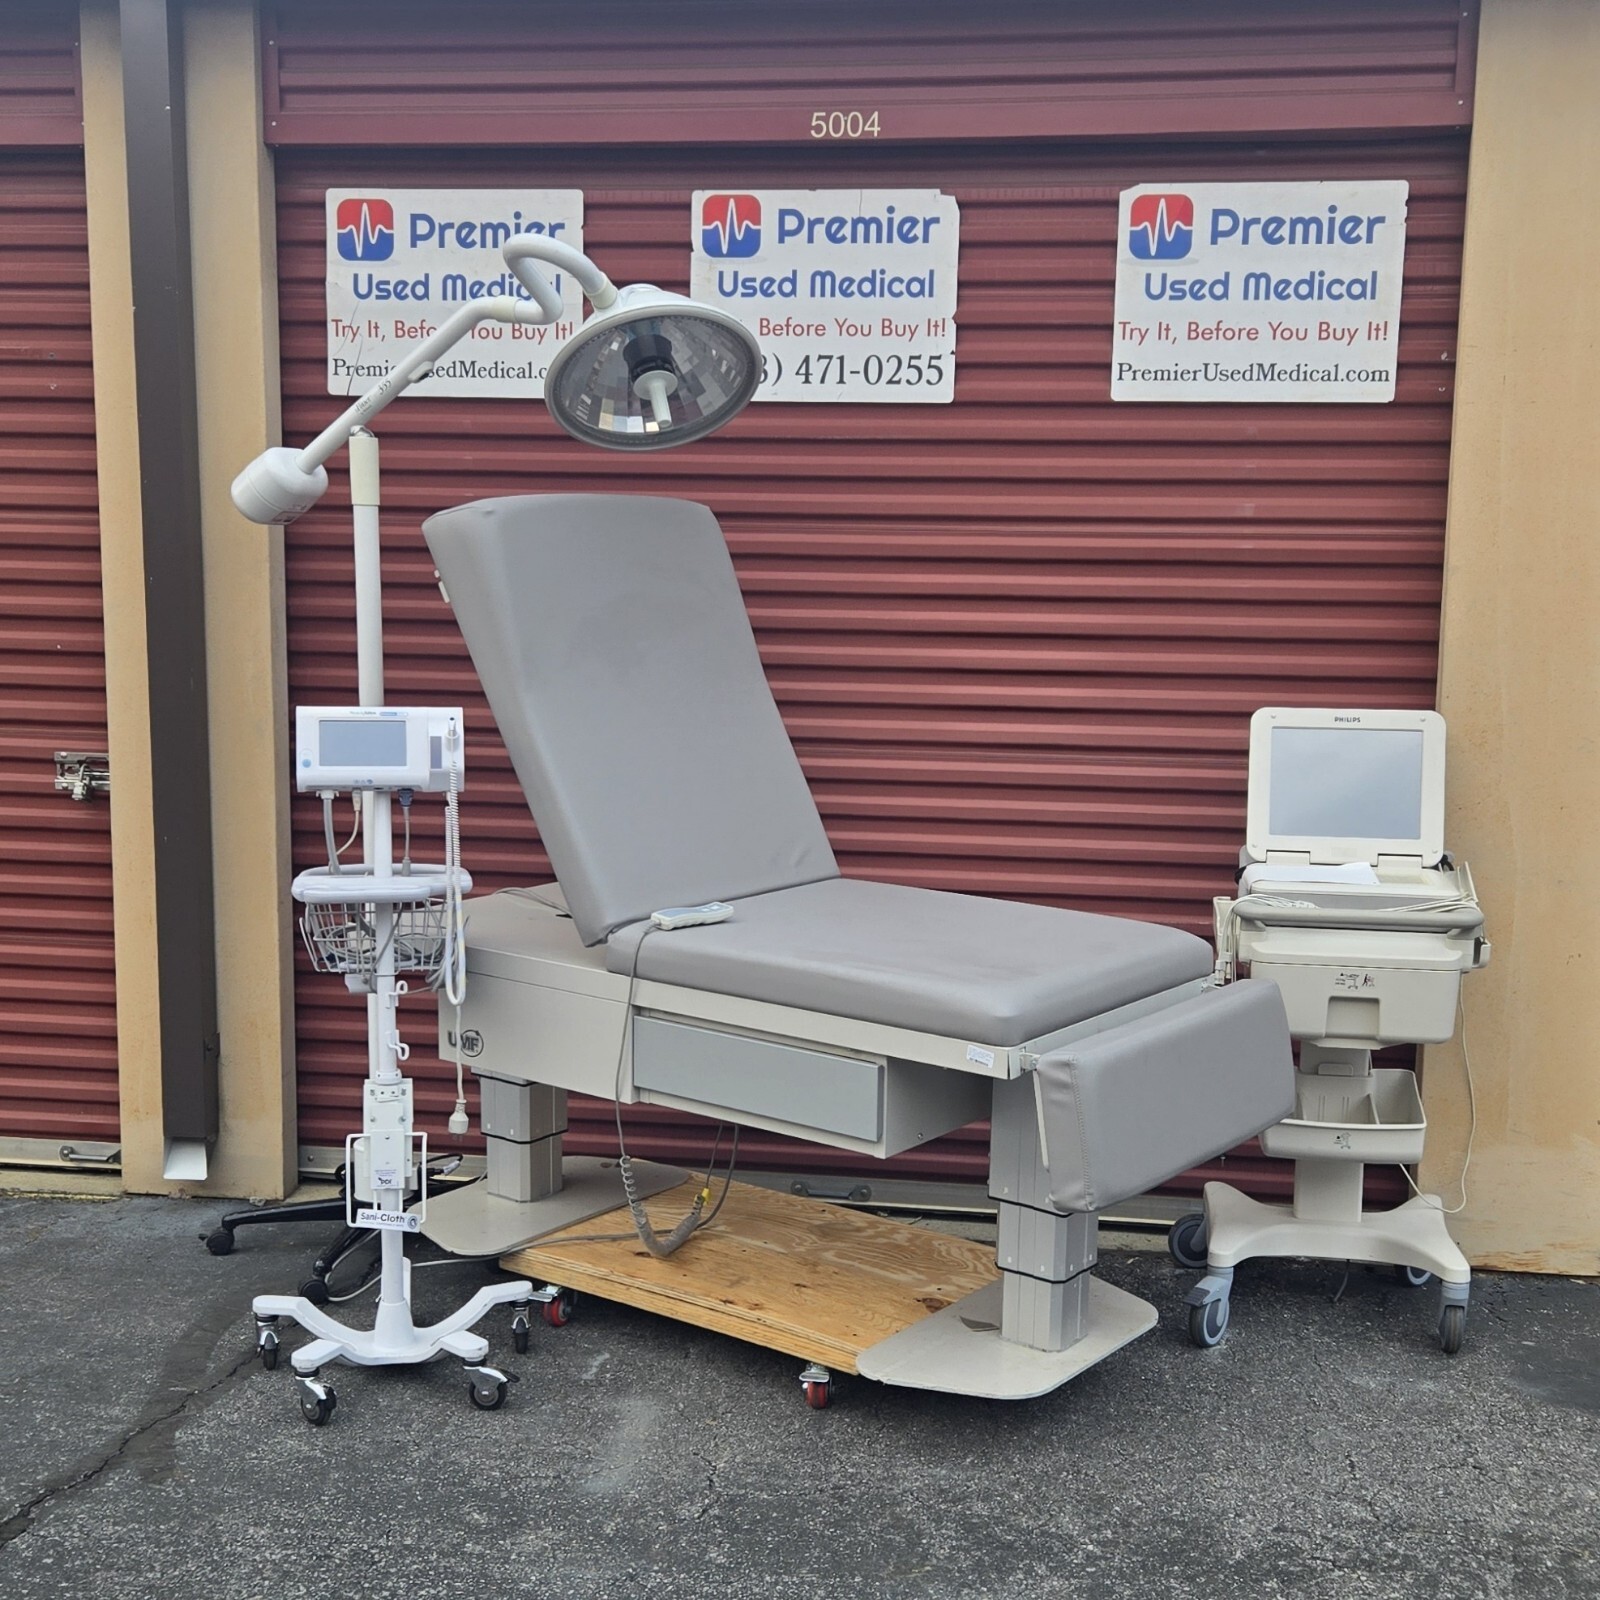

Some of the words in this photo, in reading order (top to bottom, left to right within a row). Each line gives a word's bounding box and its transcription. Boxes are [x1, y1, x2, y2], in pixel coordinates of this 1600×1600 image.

[810, 111, 881, 138] 5004
[777, 205, 940, 245] Premier
[1210, 204, 1386, 246] Premier
[352, 273, 430, 301] Used
[442, 273, 561, 301] Medicl
[718, 269, 798, 298] Used
[810, 268, 935, 298] Medical
[1145, 271, 1230, 301] Used
[1243, 270, 1378, 301] Medical
[331, 319, 360, 343] Try
[368, 320, 386, 342] It,
[512, 322, 547, 345] Buy
[759, 317, 827, 337] Before
[834, 318, 872, 337] You
[881, 318, 919, 342] Buy
[927, 318, 946, 337] It!
[1118, 321, 1149, 346] Try
[1157, 321, 1178, 345] It,
[1187, 320, 1259, 341] Before
[1268, 321, 1308, 341] You
[1318, 321, 1359, 346] Buy
[1367, 321, 1389, 341] It!
[795, 354, 944, 386] 471-0255
[1116, 362, 1390, 382] PremierUsedMedical.com
[360, 1212, 405, 1224] Sani-Cloth
